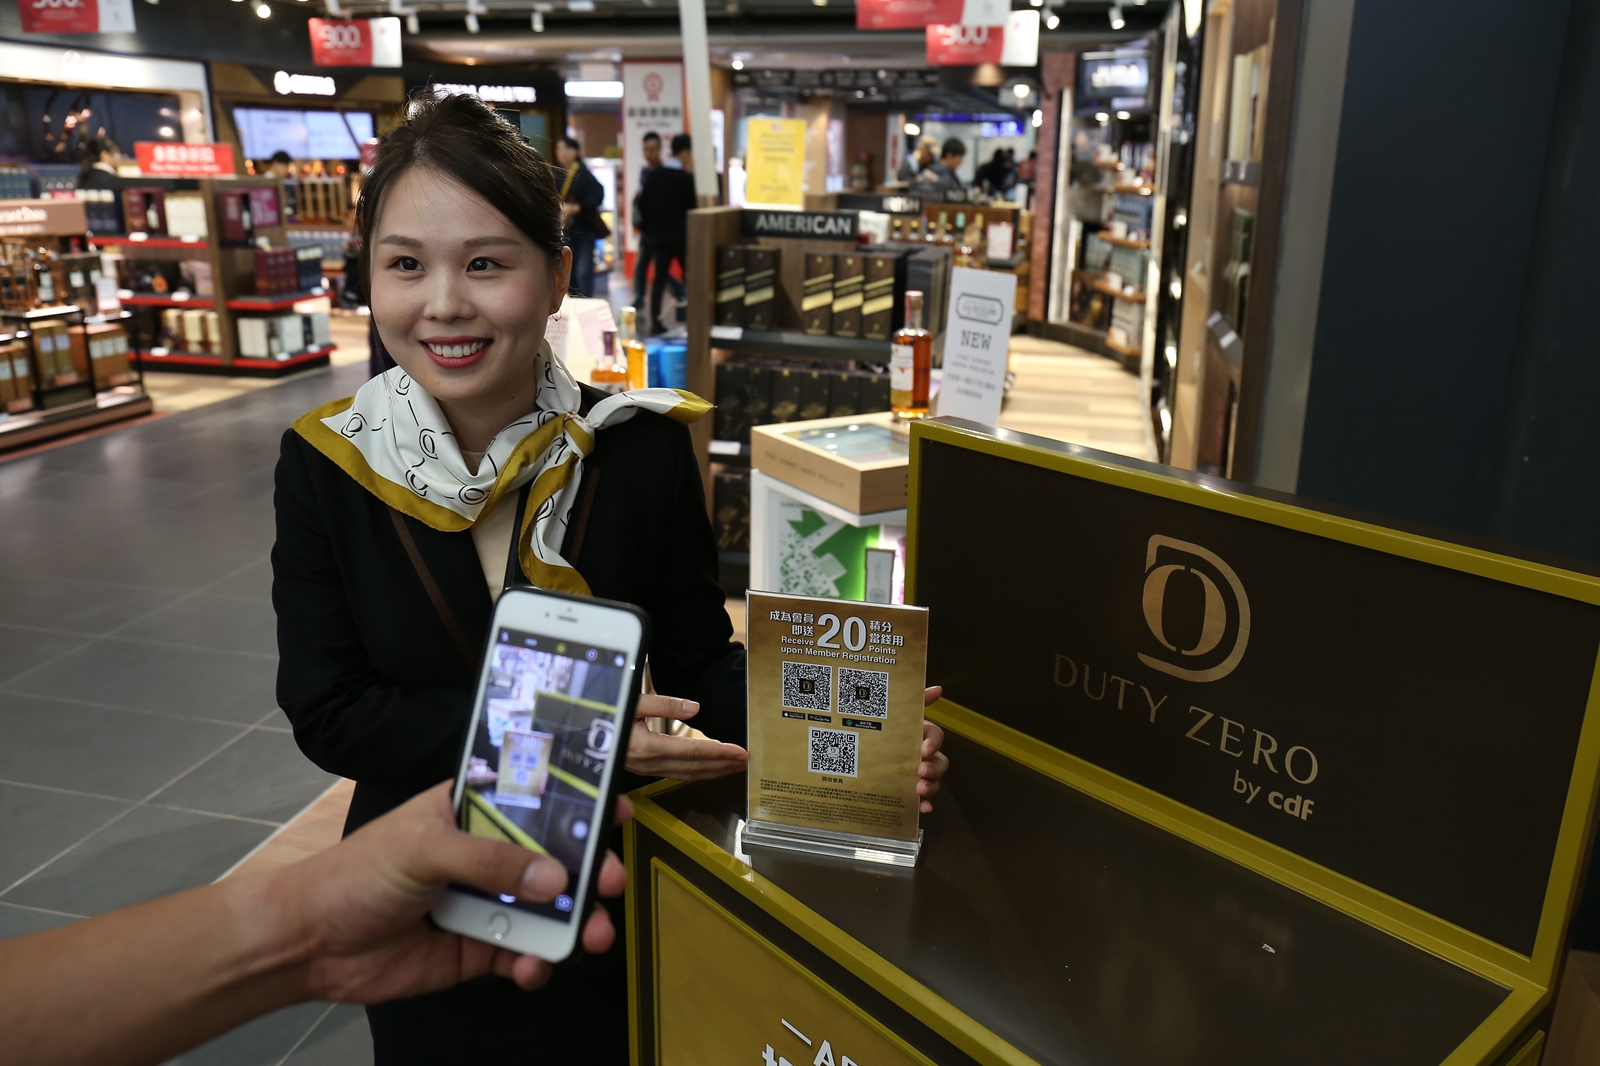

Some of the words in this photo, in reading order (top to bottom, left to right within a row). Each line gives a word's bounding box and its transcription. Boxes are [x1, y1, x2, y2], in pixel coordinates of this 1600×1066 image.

[755, 214, 851, 235] AMERICAN
[961, 330, 992, 351] NEW
[769, 610, 814, 624] 成為會員
[792, 625, 814, 637] 即送
[817, 613, 867, 652] 20
[869, 620, 892, 633] 積分
[781, 636, 814, 646] Receive
[869, 633, 904, 646] 當錢用
[781, 646, 803, 655] upon
[805, 648, 840, 658] Member
[842, 652, 896, 665] Registration
[869, 645, 896, 655] Points
[1053, 652, 1168, 723] DUTY
[1185, 706, 1319, 785] ZERO
[1234, 770, 1261, 804] by
[1268, 791, 1315, 821] cdf
